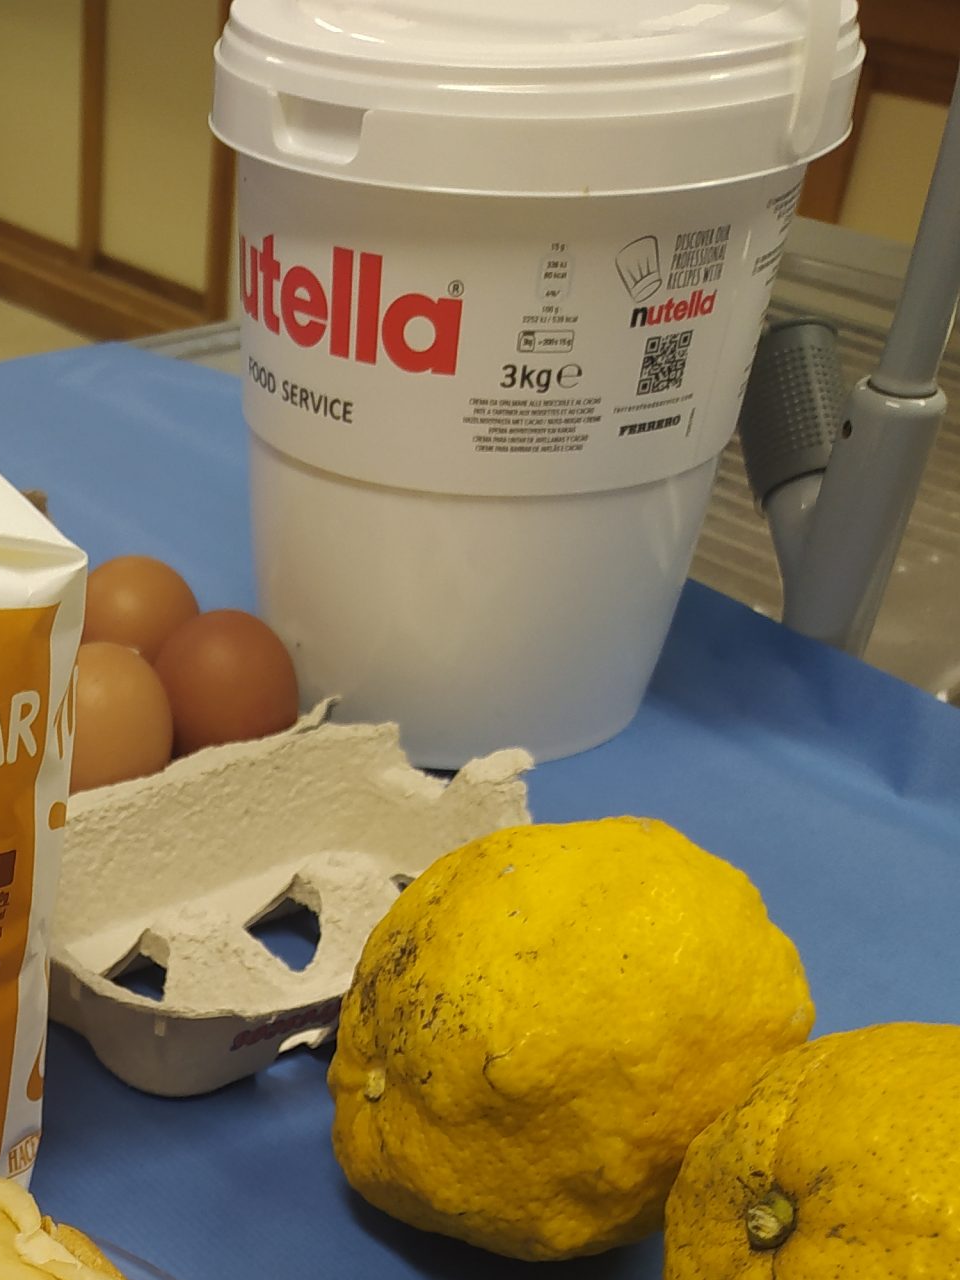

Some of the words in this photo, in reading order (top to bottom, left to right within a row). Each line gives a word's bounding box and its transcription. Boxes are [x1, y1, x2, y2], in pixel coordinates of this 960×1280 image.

[675, 228, 714, 251] DISCOVER
[671, 240, 727, 271] PROFESSIONAL
[667, 267, 701, 290] RECIPES
[703, 262, 723, 283] WITH
[241, 234, 462, 376] utella
[630, 289, 717, 328] nutella
[249, 356, 276, 393] FOOD
[282, 380, 353, 424] SERVICE
[500, 364, 552, 393] 3kg
[619, 414, 681, 437] FERRERO
